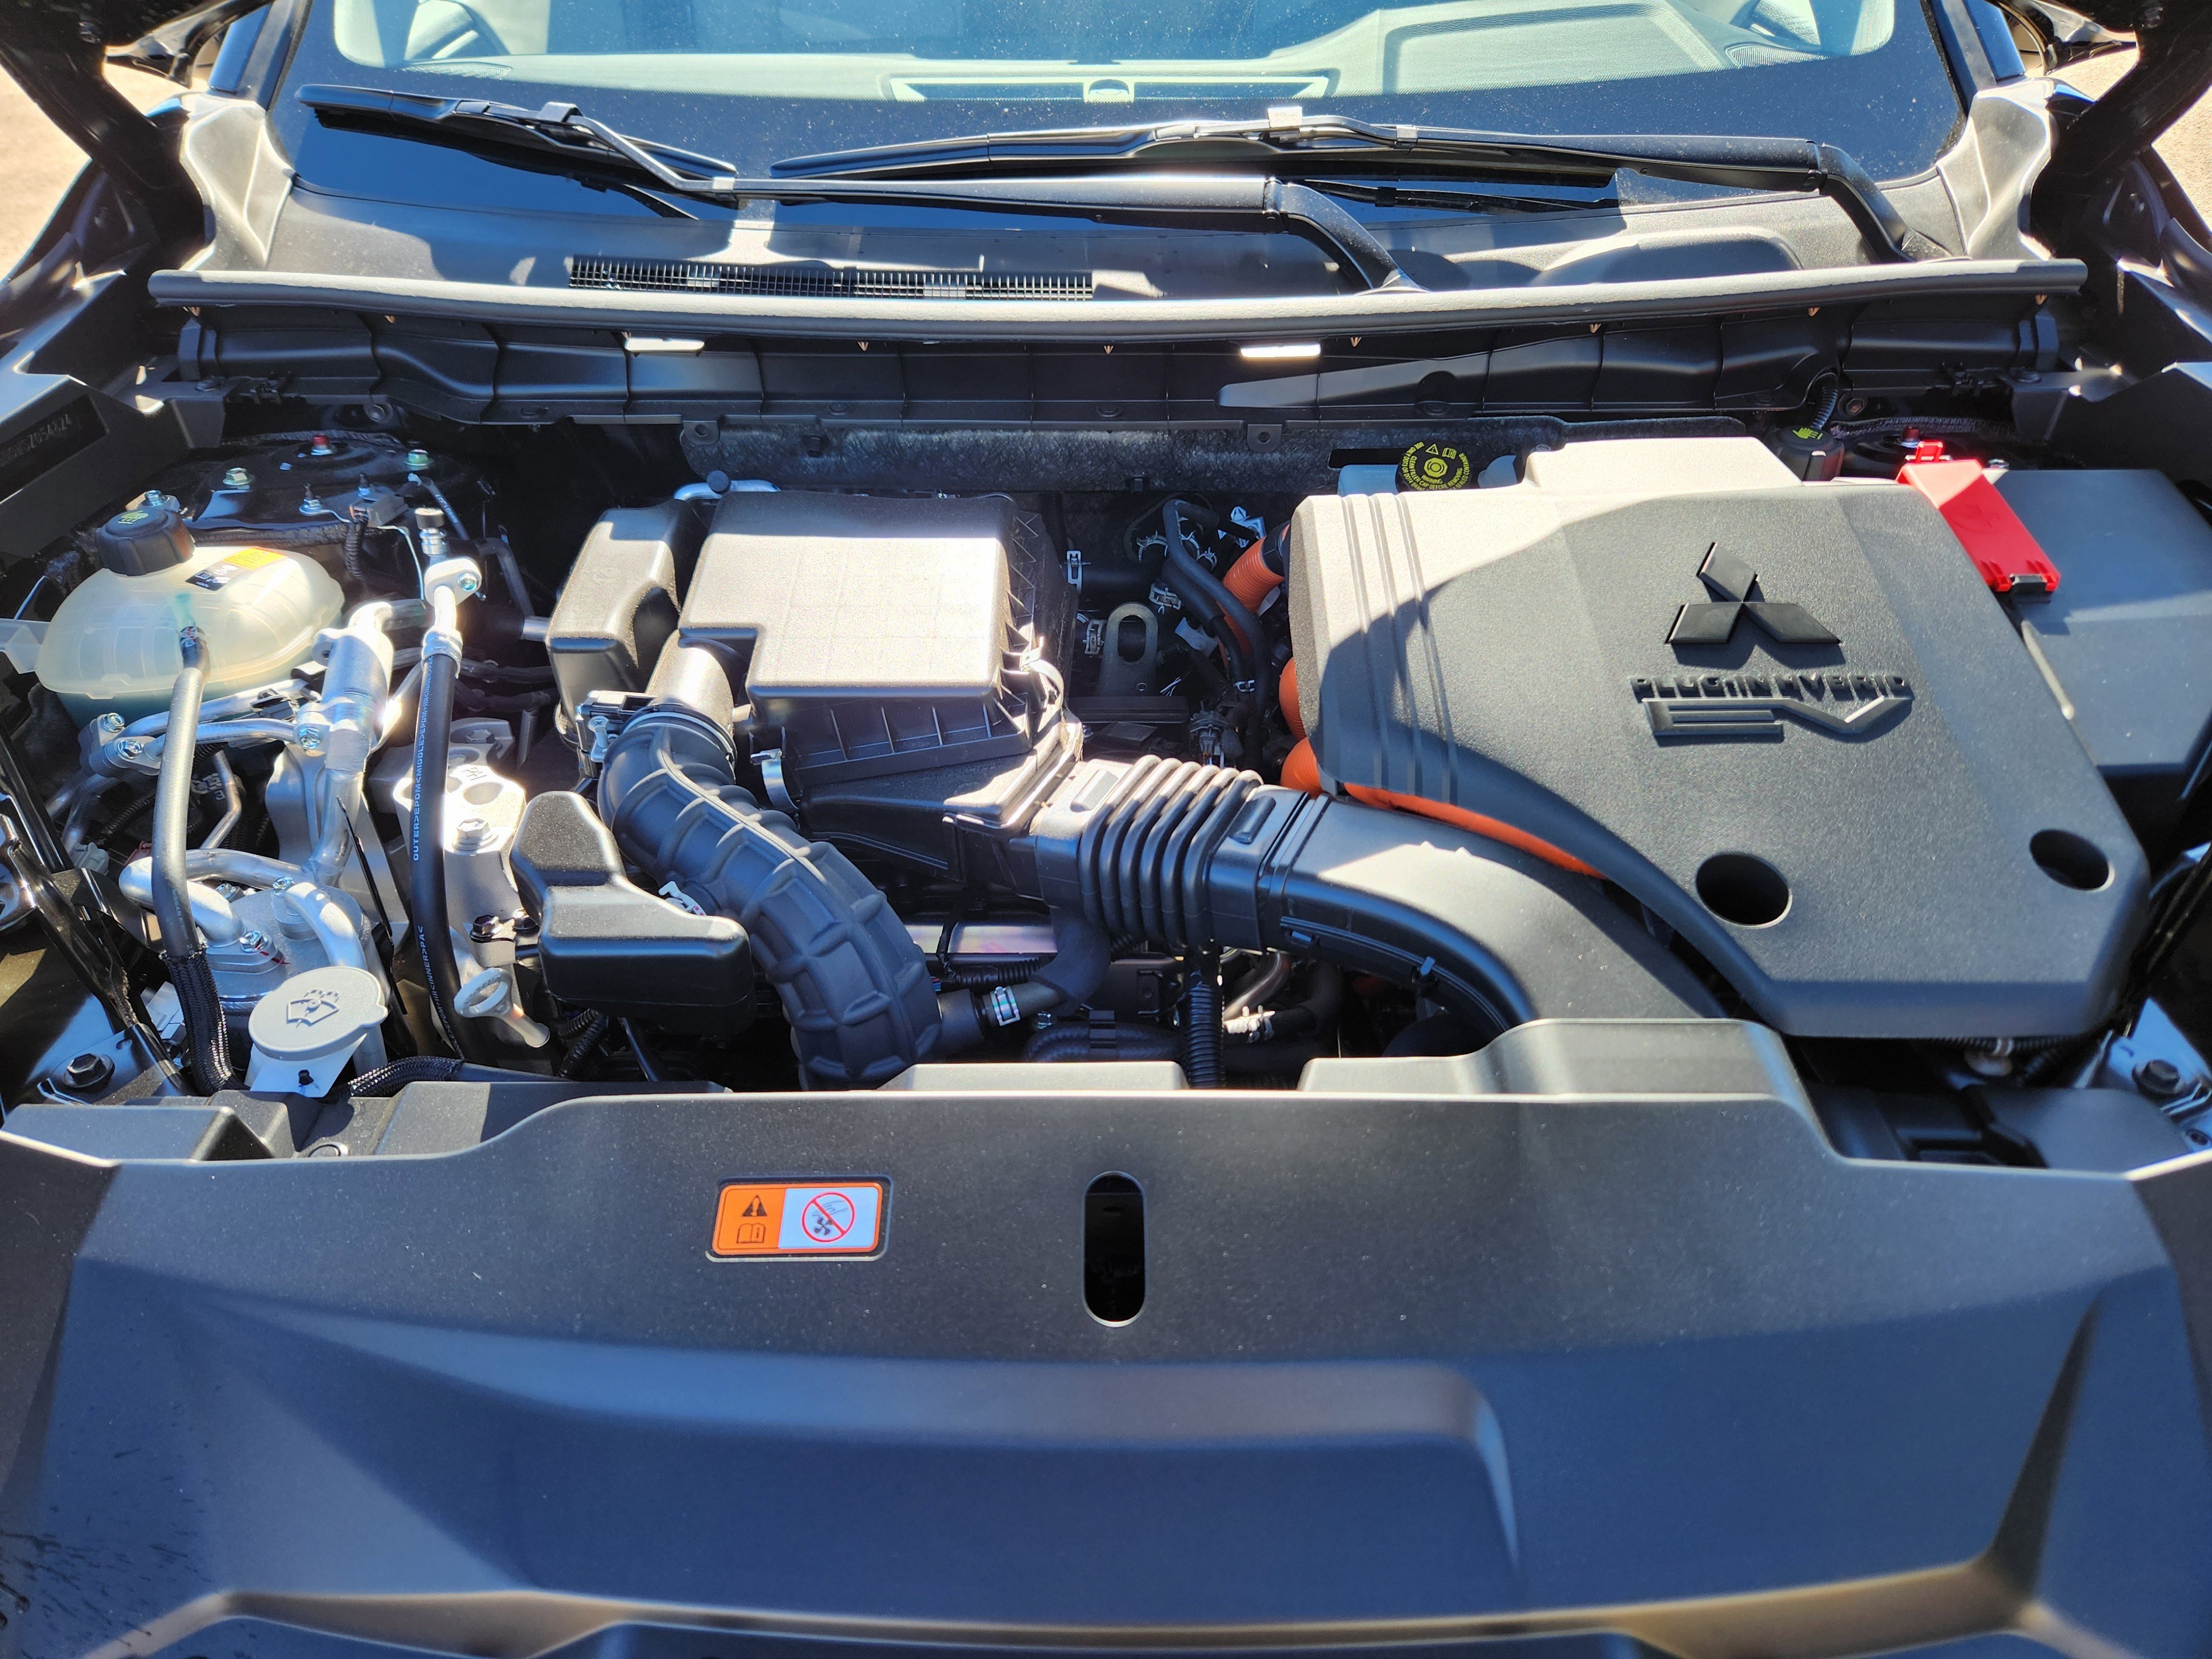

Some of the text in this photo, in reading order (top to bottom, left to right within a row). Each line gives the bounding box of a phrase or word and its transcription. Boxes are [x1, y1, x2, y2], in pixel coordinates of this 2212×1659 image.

[1409, 455, 1417, 469] CLEAN
[1447, 468, 1463, 487] REMOVING
[1421, 474, 1443, 484] WARNING
[1773, 674, 1913, 697] HYBRID
